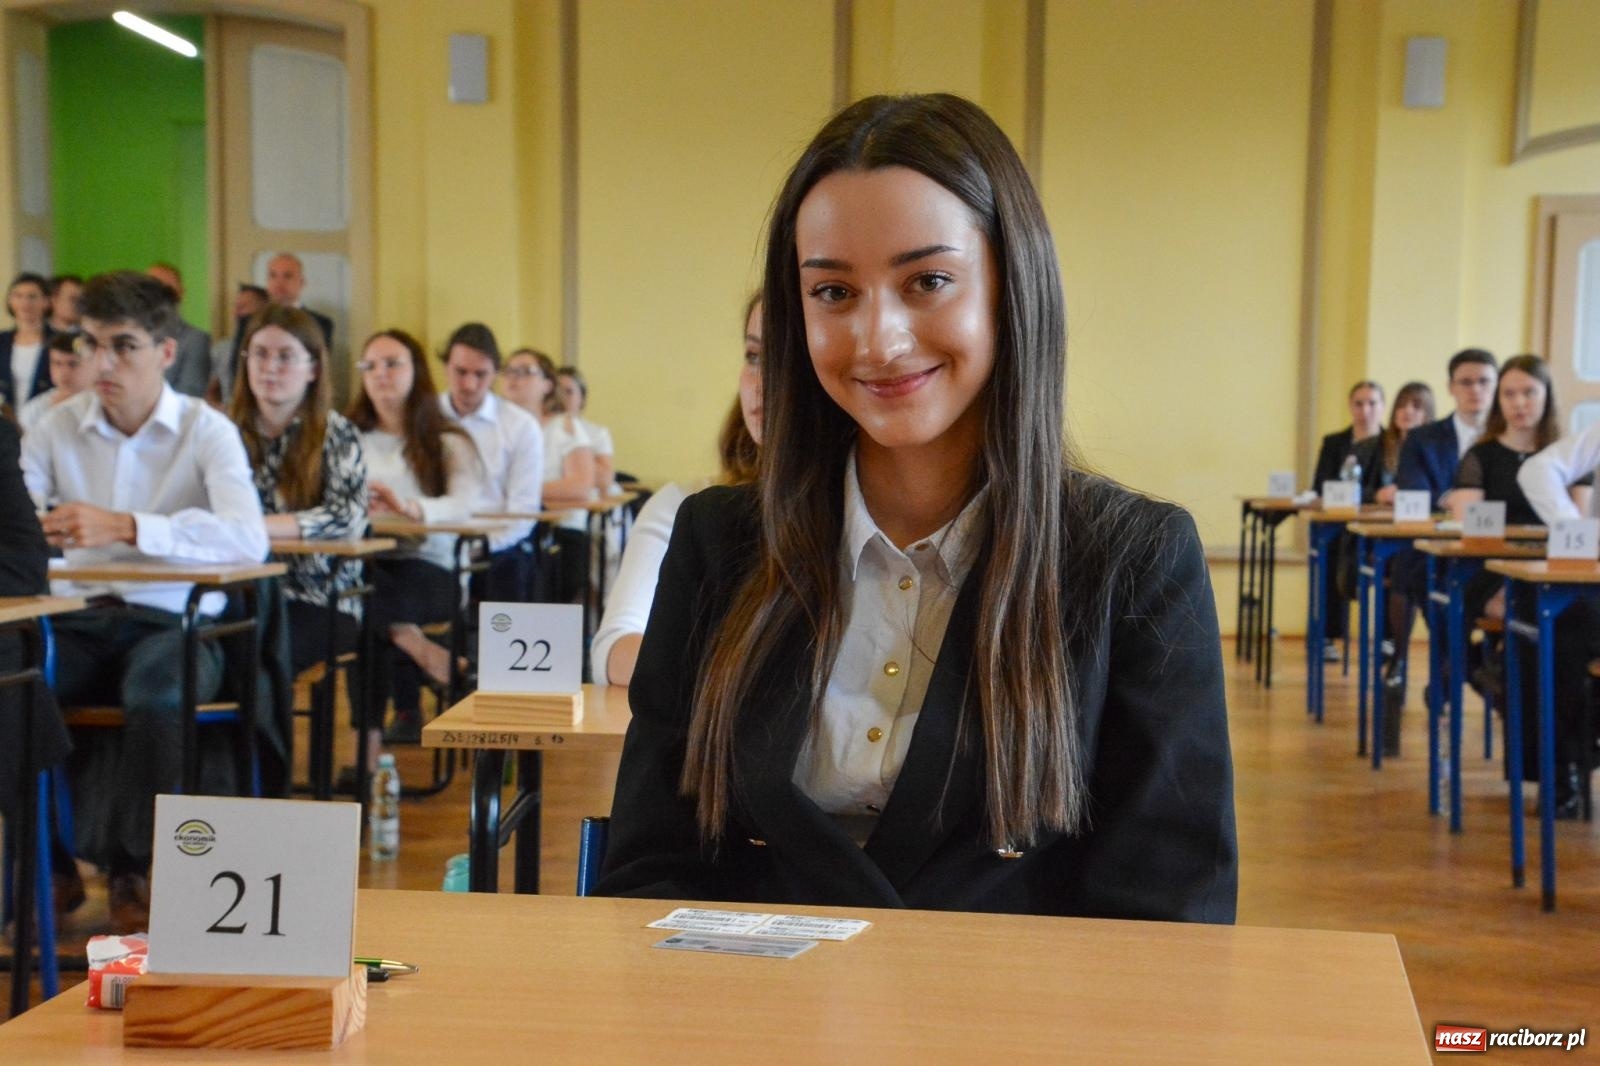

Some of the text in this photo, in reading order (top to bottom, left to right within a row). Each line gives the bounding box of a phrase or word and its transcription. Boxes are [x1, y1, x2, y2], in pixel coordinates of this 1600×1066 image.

[1475, 515, 1494, 529] 16
[1564, 532, 1586, 549] 15
[508, 638, 552, 672] 22
[206, 870, 286, 936] 21
